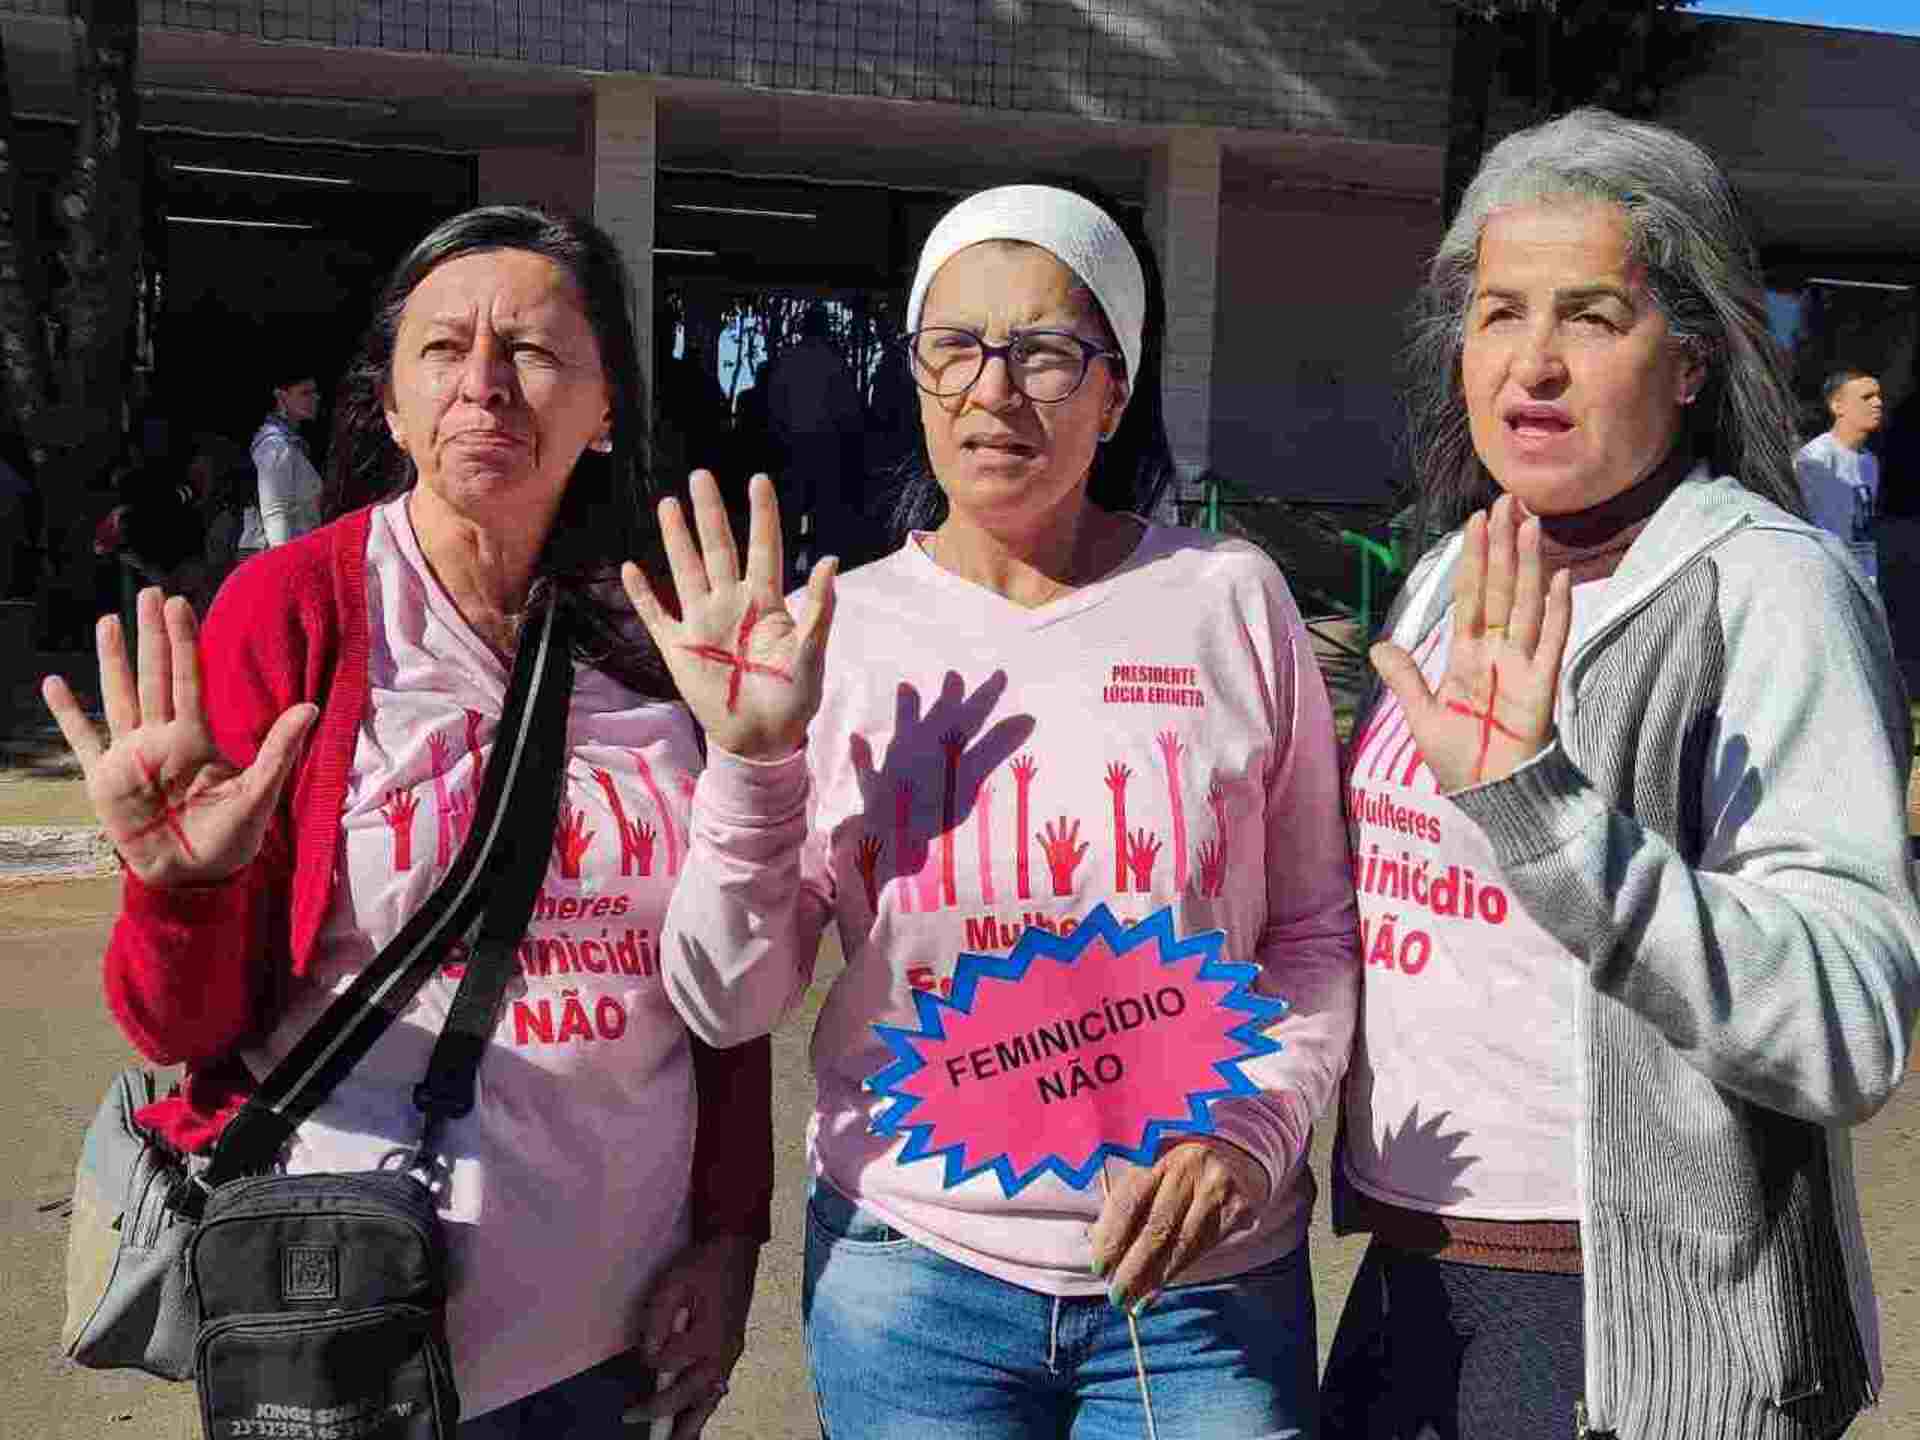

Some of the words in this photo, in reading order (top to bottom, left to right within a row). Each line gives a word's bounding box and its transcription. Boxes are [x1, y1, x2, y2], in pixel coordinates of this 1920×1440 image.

[1103, 683, 1145, 704] LÚCIA
[1112, 664, 1197, 686] PRESIDENTE
[513, 989, 627, 1046] NÃO
[945, 986, 1187, 1087] FEMINICÍDIO
[1036, 1051, 1124, 1105] NÃO
